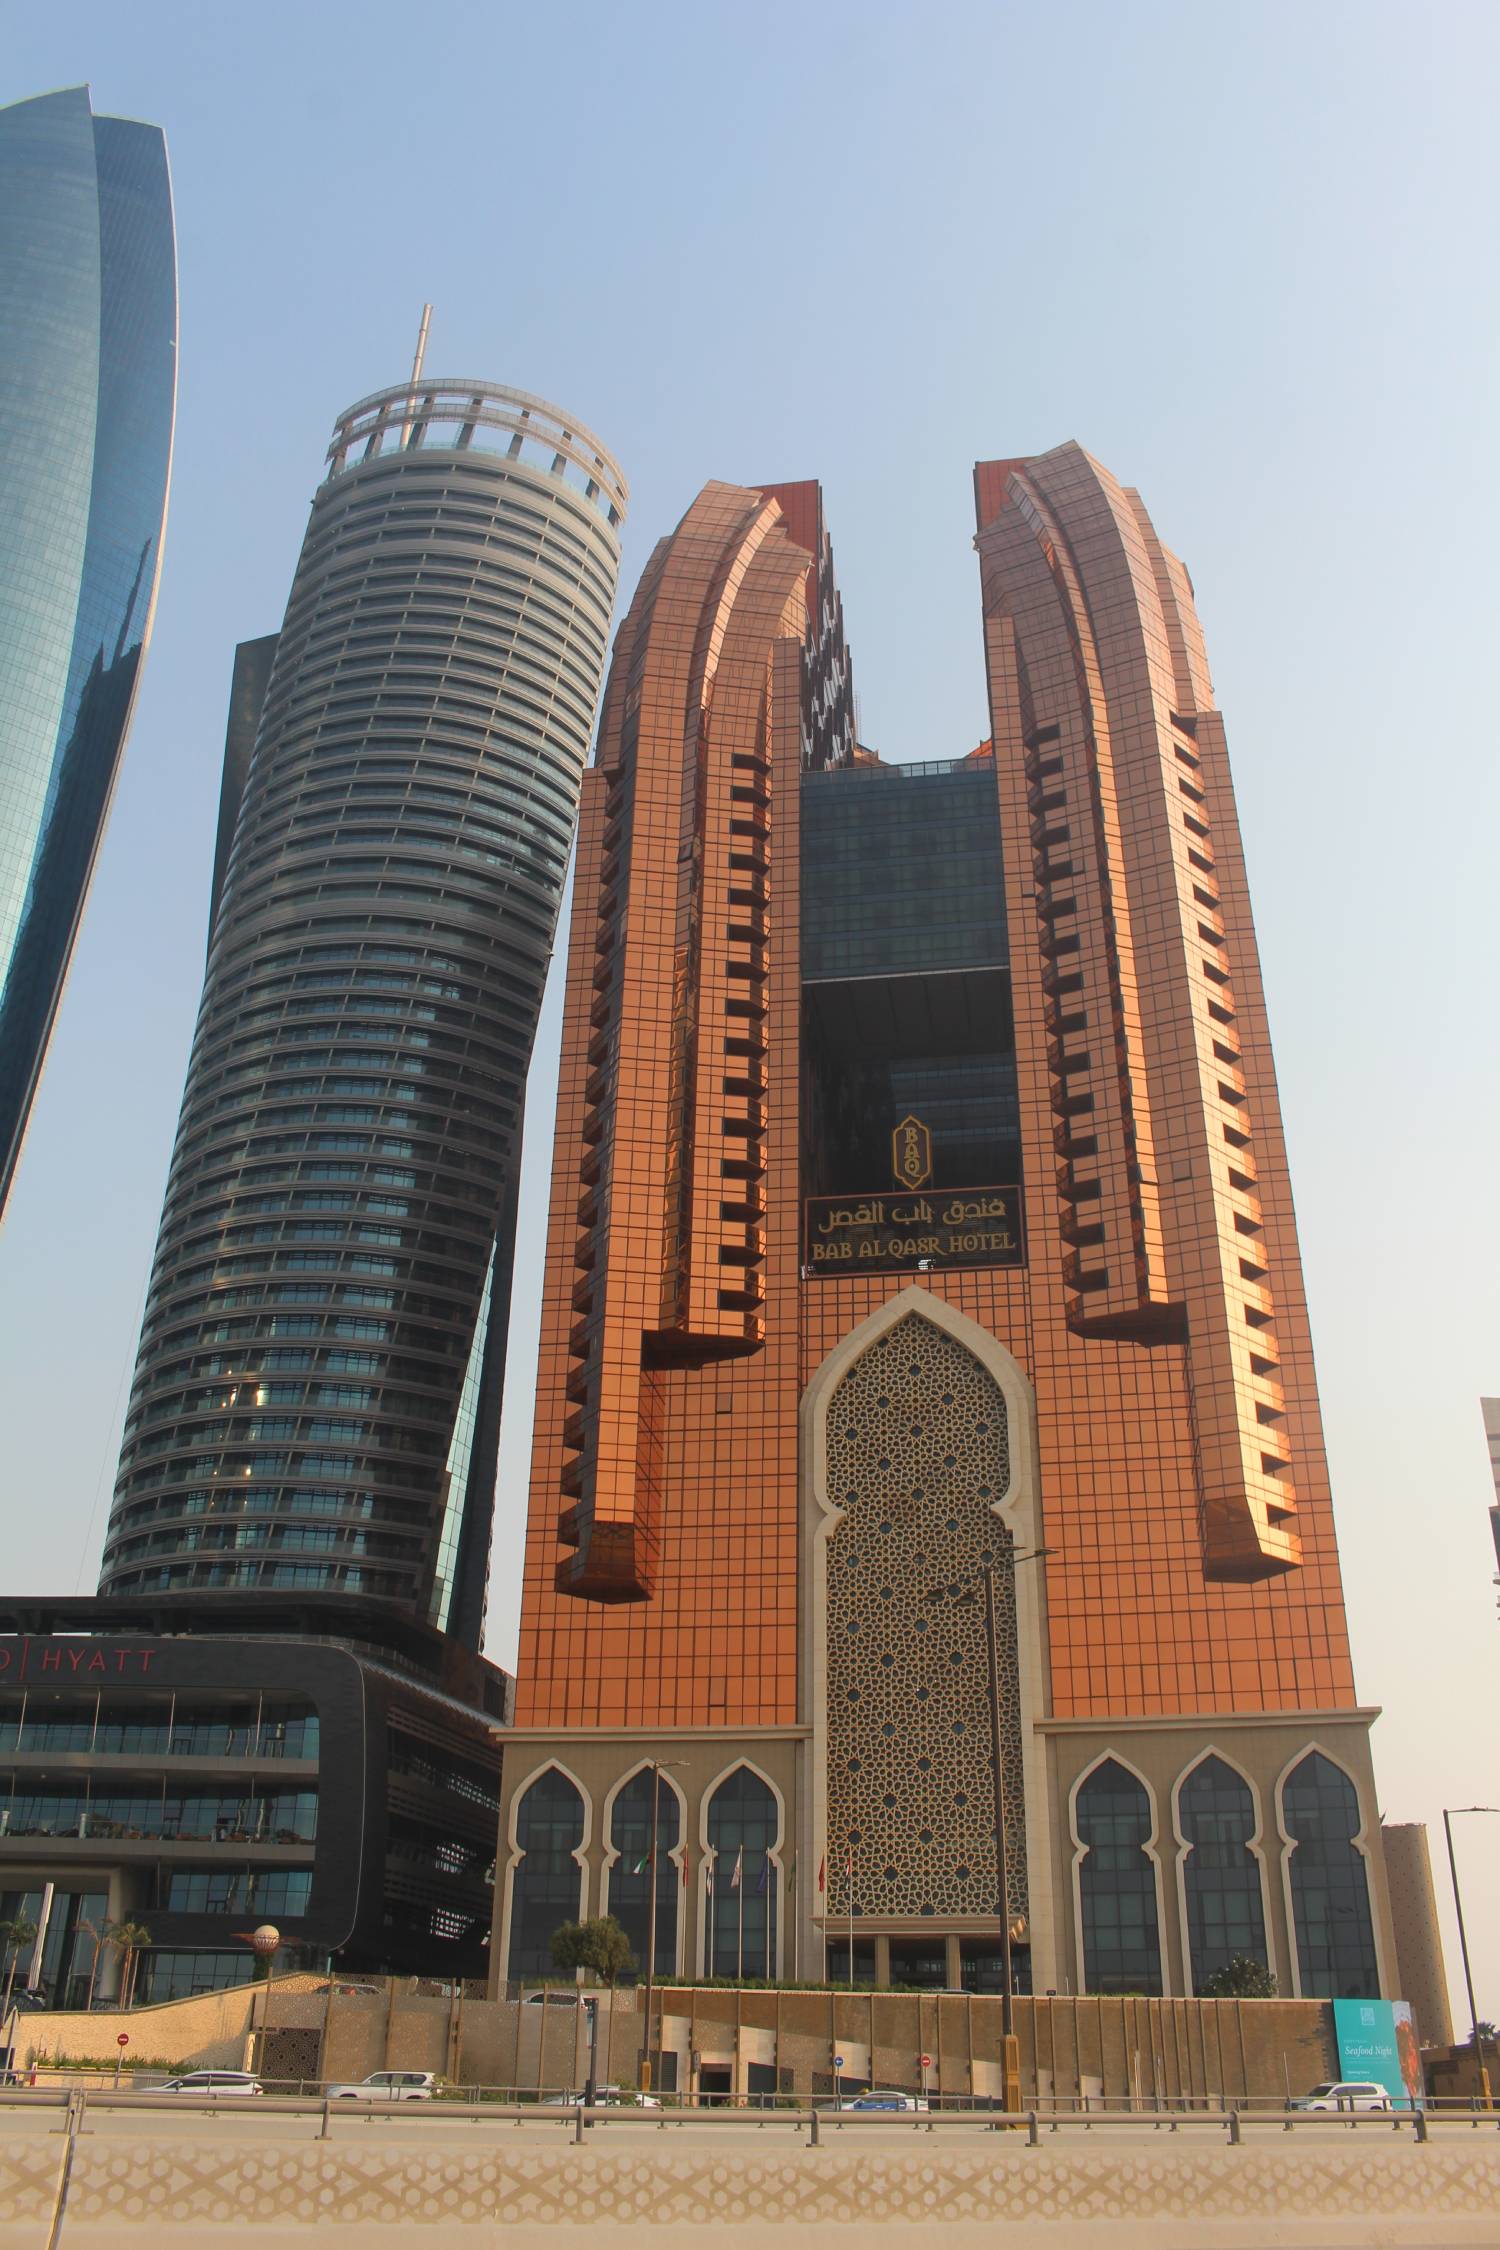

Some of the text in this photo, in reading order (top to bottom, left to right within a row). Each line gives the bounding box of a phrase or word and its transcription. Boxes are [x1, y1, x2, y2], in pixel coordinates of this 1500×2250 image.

[904, 1127, 920, 1177] BAQ
[818, 1198, 1006, 1233] فندق باب القصر
[812, 1232, 1016, 1261] BAB AL QASR HOTEL
[42, 1648, 157, 1673] HYATT
[1344, 2045, 1393, 2057] Seafood Night
